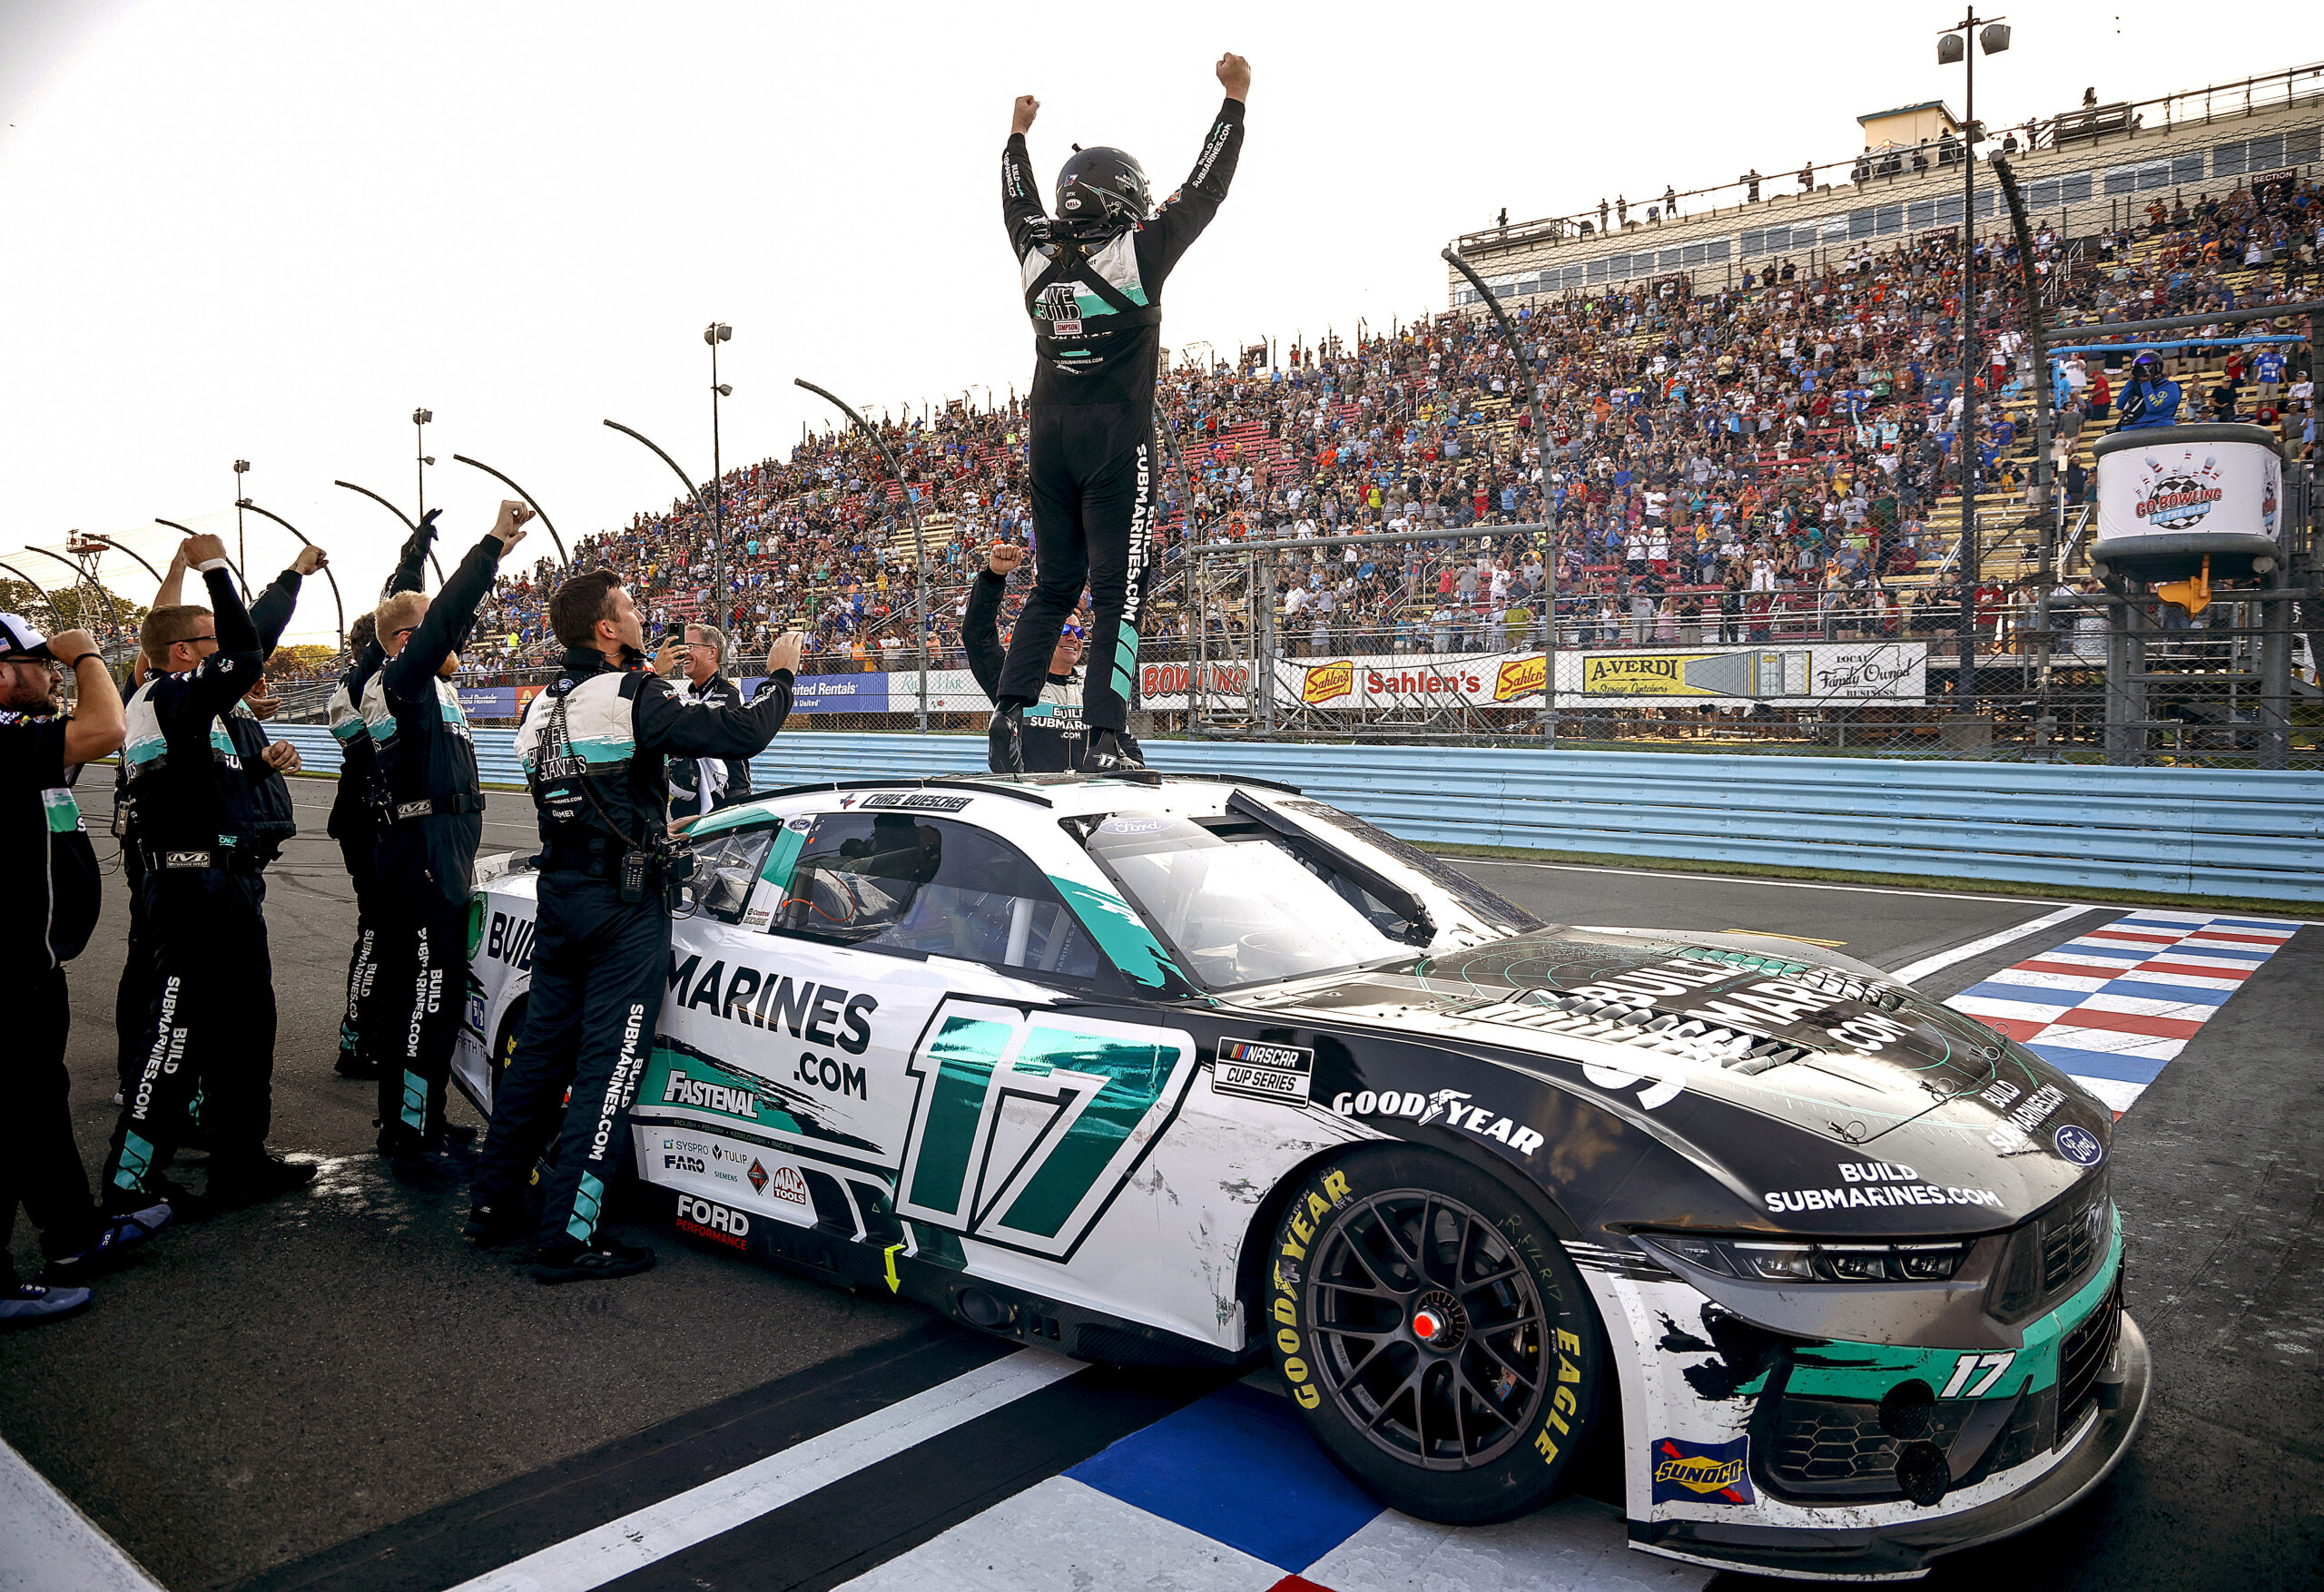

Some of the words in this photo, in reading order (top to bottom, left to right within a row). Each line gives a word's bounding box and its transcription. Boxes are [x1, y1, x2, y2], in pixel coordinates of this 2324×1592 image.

[1198, 142, 1214, 165] BUILD
[1011, 163, 1020, 181] BUILD
[2253, 171, 2293, 183] SECTION
[1045, 287, 1074, 305] WE
[1036, 303, 1081, 320] BUILD
[1057, 323, 1078, 331] SIMPSON
[2136, 498, 2157, 518] GO
[2160, 487, 2222, 510] BOWLING
[2152, 513, 2164, 523] AT
[2166, 509, 2183, 520] THE
[2185, 504, 2210, 516] GLEN
[1121, 443, 1149, 622] SUBMARINES.COM
[1590, 658, 1678, 683] A-VERDI
[1837, 654, 1868, 664] LOCAL
[1307, 667, 1350, 694] Sahlen's
[1367, 671, 1480, 693] Sahlen's
[1500, 663, 1546, 693] Sahlen'
[1817, 666, 1860, 692] Family
[1864, 657, 1912, 682] Owned
[792, 683, 817, 696] nited
[818, 682, 856, 695] Rentals
[1600, 683, 1629, 694] Storage
[1630, 683, 1669, 694] Containers
[799, 699, 820, 707] United
[1060, 732, 1081, 740] .COM
[1098, 753, 1117, 768] 17
[905, 794, 974, 810] BUESCHER
[1115, 819, 1162, 833] Ford
[753, 909, 771, 918] Castrol
[487, 910, 535, 972] BUIL
[350, 929, 375, 1021] SUBMARINES.CO
[360, 963, 378, 997] BUILD
[428, 969, 443, 1013] BUILD
[133, 976, 181, 1120] SUBMARINES.COM
[163, 1027, 188, 1075] BUILD
[1246, 1045, 1299, 1067] NASCAR
[588, 1004, 645, 1161] SUBMARINES.COM
[621, 1058, 644, 1108] BUILD
[793, 1052, 868, 1102] .COM
[1226, 1067, 1252, 1084] CUP
[1252, 1071, 1296, 1091] SERIES
[662, 1069, 758, 1119] FASTENAL
[1979, 1080, 2023, 1109] BUILD
[891, 991, 1197, 1265] 17
[676, 1140, 709, 1155] SYSPRO
[724, 1150, 748, 1165] TULIP
[772, 1141, 794, 1152] RACING
[2059, 1129, 2098, 1163] Ford
[664, 1155, 705, 1174] FARO
[714, 1171, 738, 1183] SIEMENS
[1839, 1163, 1920, 1183] BUILD
[774, 1167, 804, 1194] MAC
[774, 1188, 805, 1204] TOOLS
[1764, 1185, 2004, 1214] SUBMARINES.COM
[677, 1194, 749, 1236] FORD
[675, 1218, 748, 1251] PERFORMANCE
[1938, 1350, 2016, 1399] 17
[1533, 1326, 1581, 1465] EAGLE
[1655, 1458, 1745, 1489] SUNOCO
